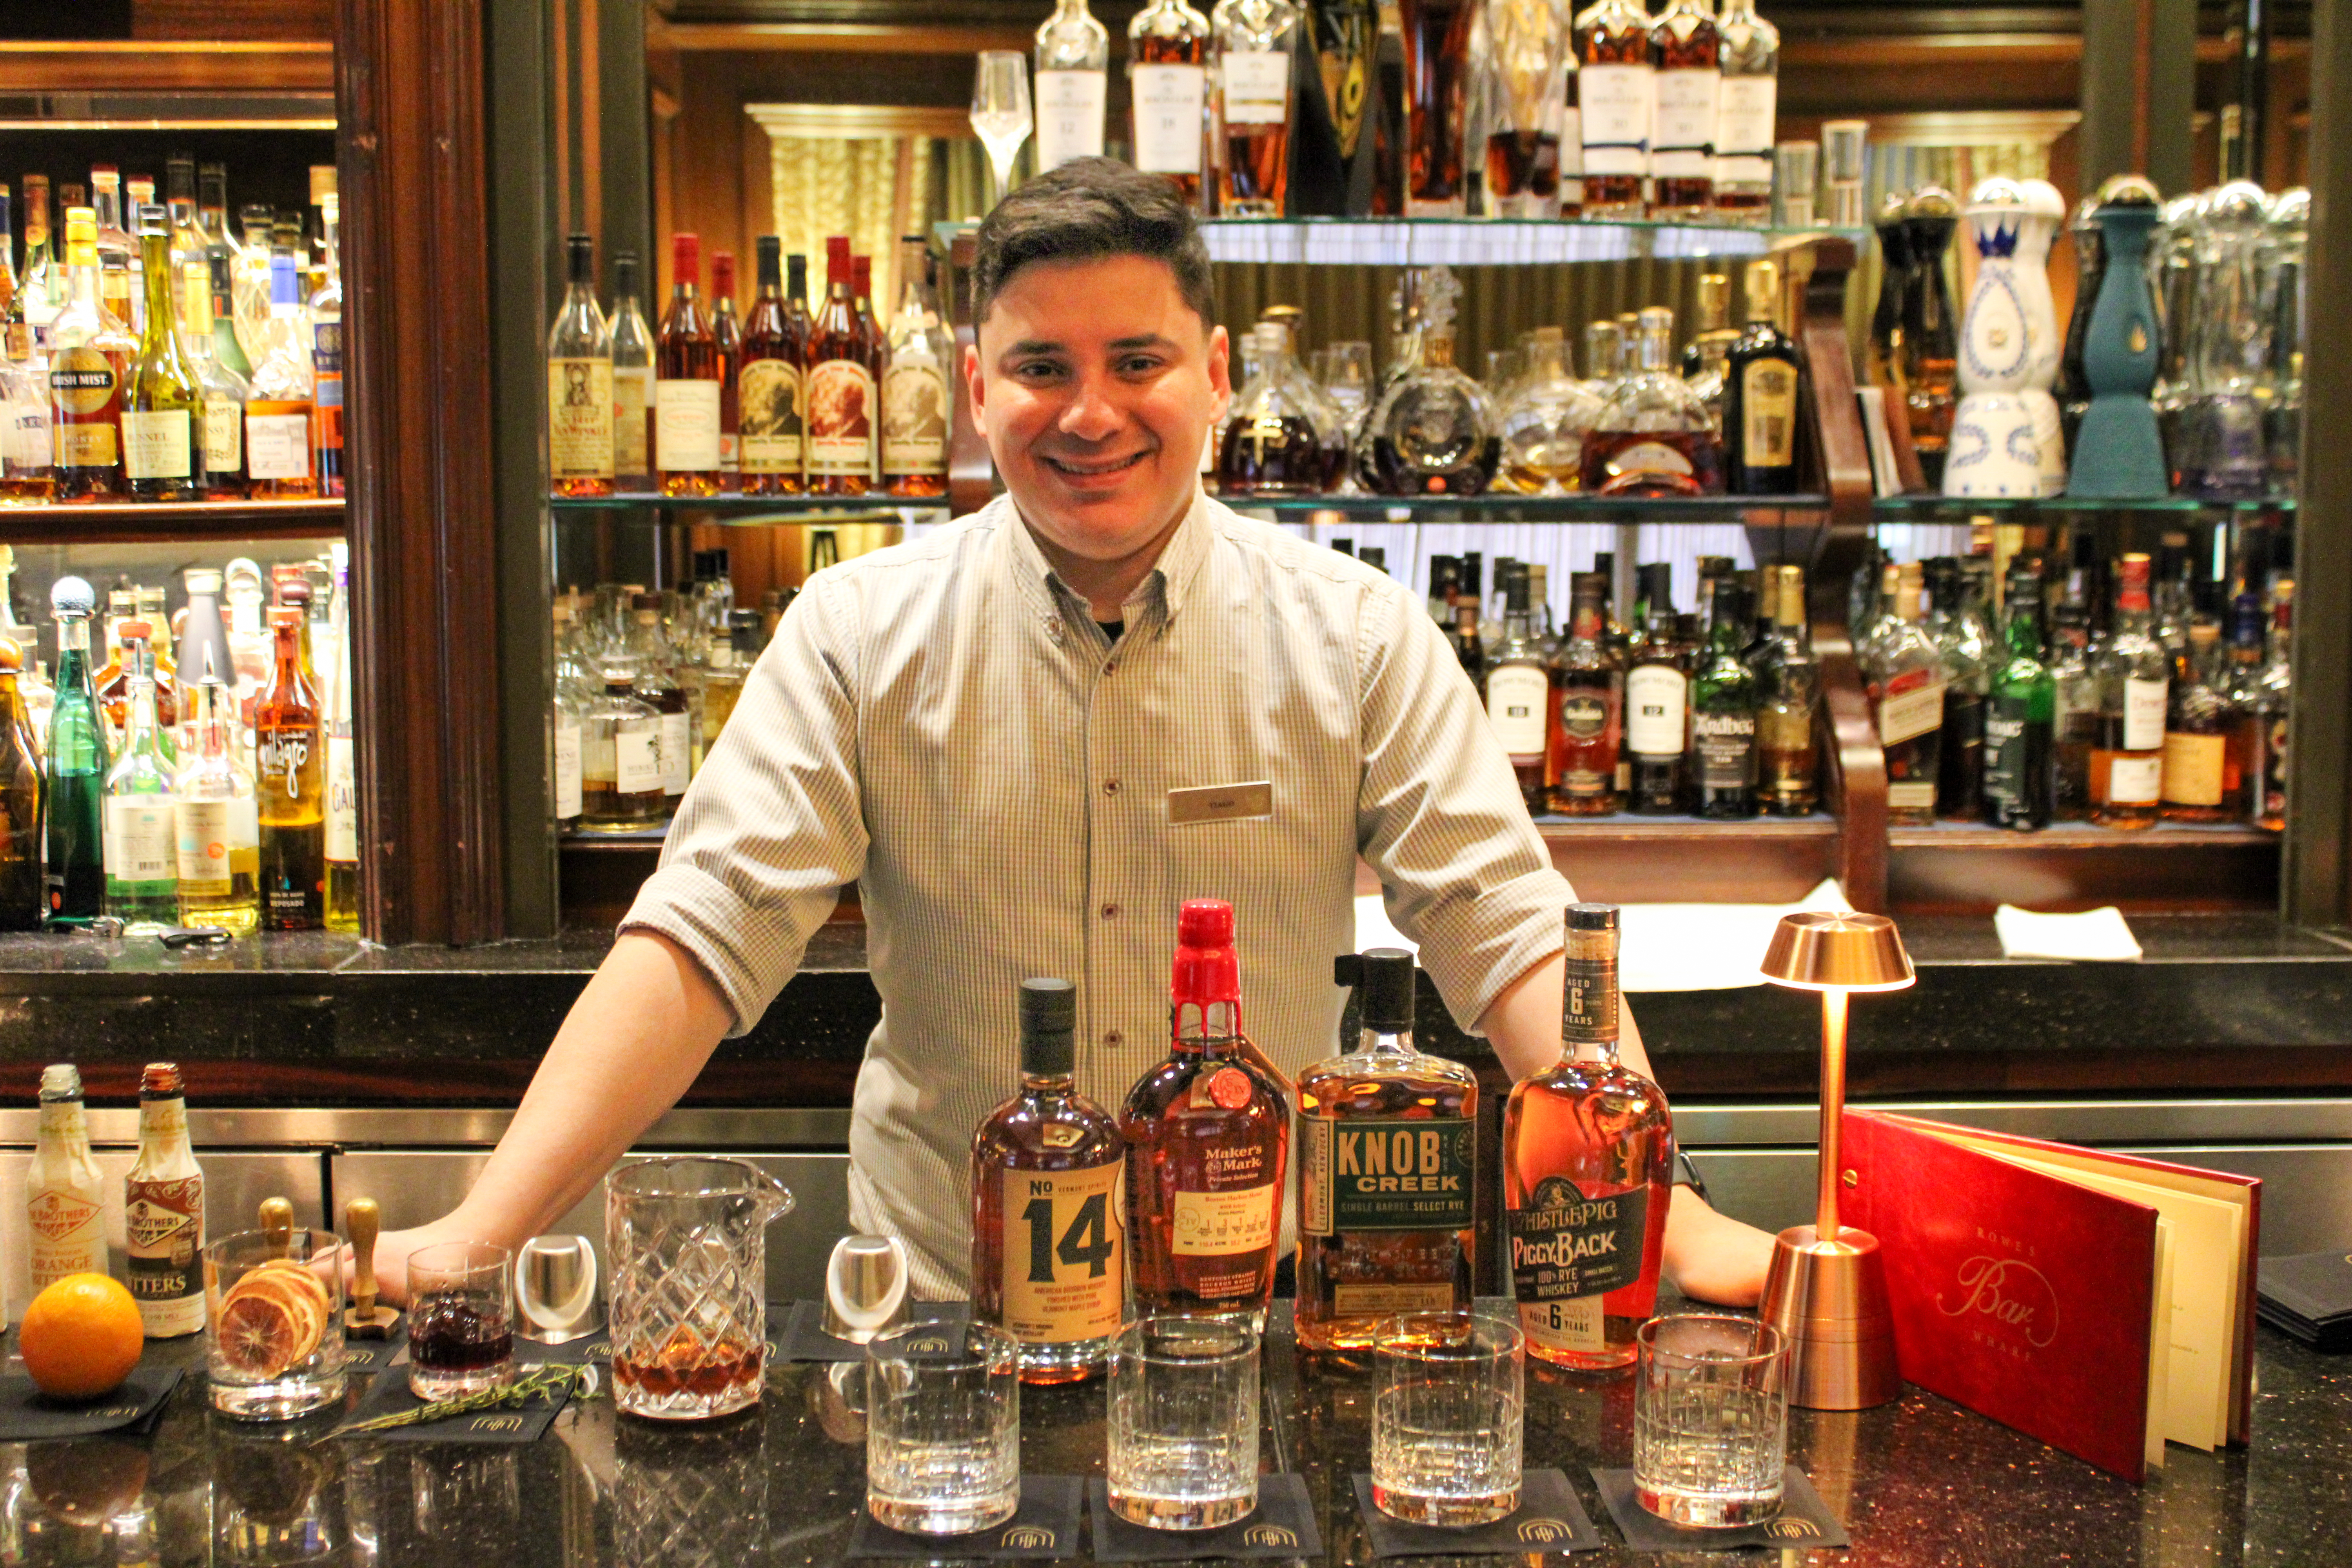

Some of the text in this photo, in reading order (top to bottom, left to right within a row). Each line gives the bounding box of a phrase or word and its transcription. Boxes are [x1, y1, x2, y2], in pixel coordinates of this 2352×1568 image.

[1568, 978, 1590, 988] AGED
[1571, 987, 1583, 1015] 6
[1565, 1014, 1593, 1025] YEARS
[1205, 1145, 1262, 1160] Maker's
[1338, 1131, 1441, 1175] KNOB
[1357, 1176, 1460, 1192] CREEK
[1341, 1200, 1465, 1213] SINGLE BARREL SELECT RYE
[1021, 1191, 1114, 1283] 14
[1558, 1267, 1577, 1281] RYE
[1537, 1282, 1579, 1297] WHISKEY
[1935, 1256, 2059, 1348] Bar
[1530, 1304, 1589, 1332] AGED 6 YEARS
